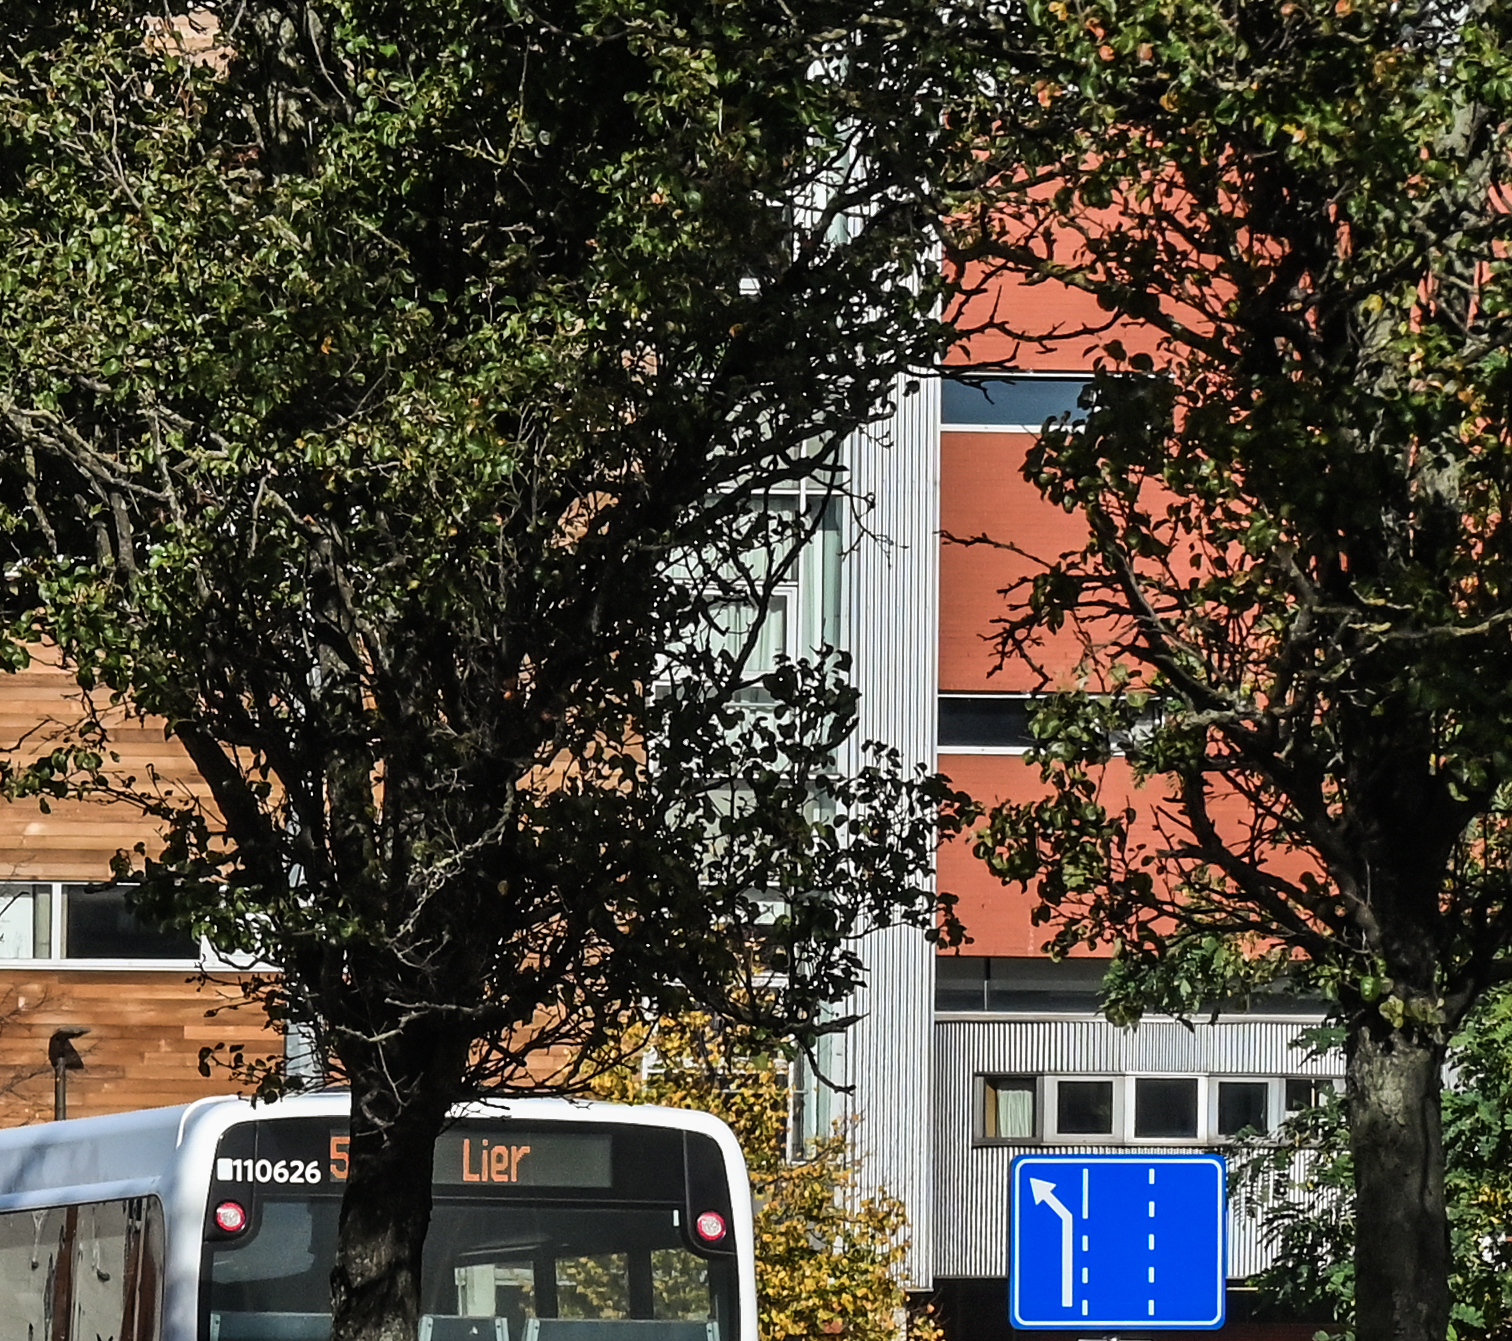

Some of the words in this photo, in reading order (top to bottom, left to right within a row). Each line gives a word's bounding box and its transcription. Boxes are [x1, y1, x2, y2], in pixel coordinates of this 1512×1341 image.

[232, 1158, 322, 1185] 110626
[329, 1135, 351, 1179] 5
[462, 1138, 531, 1182] Lier
